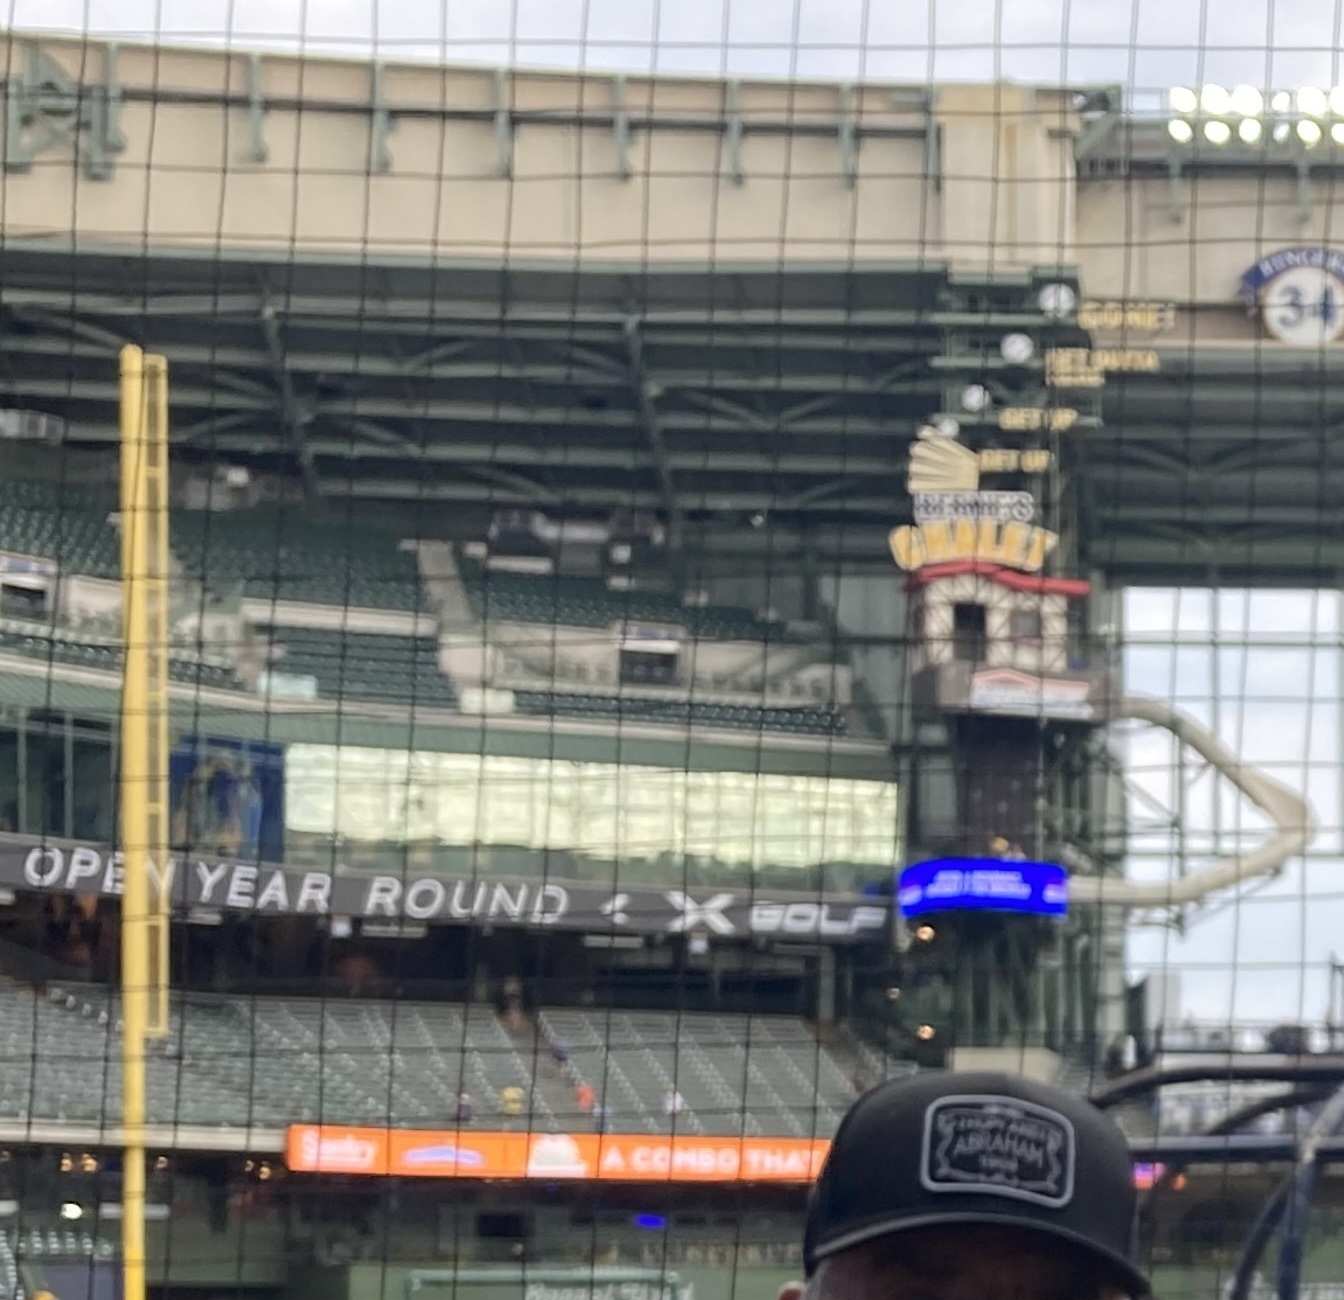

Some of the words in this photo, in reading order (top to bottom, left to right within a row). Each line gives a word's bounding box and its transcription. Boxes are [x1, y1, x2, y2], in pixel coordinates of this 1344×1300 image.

[1276, 284, 1337, 330] 34
[196, 860, 333, 913] YEAR
[363, 874, 570, 925] ROUND
[748, 900, 888, 936] GOLF
[603, 1145, 627, 1174] A
[631, 1146, 741, 1174] COMBO
